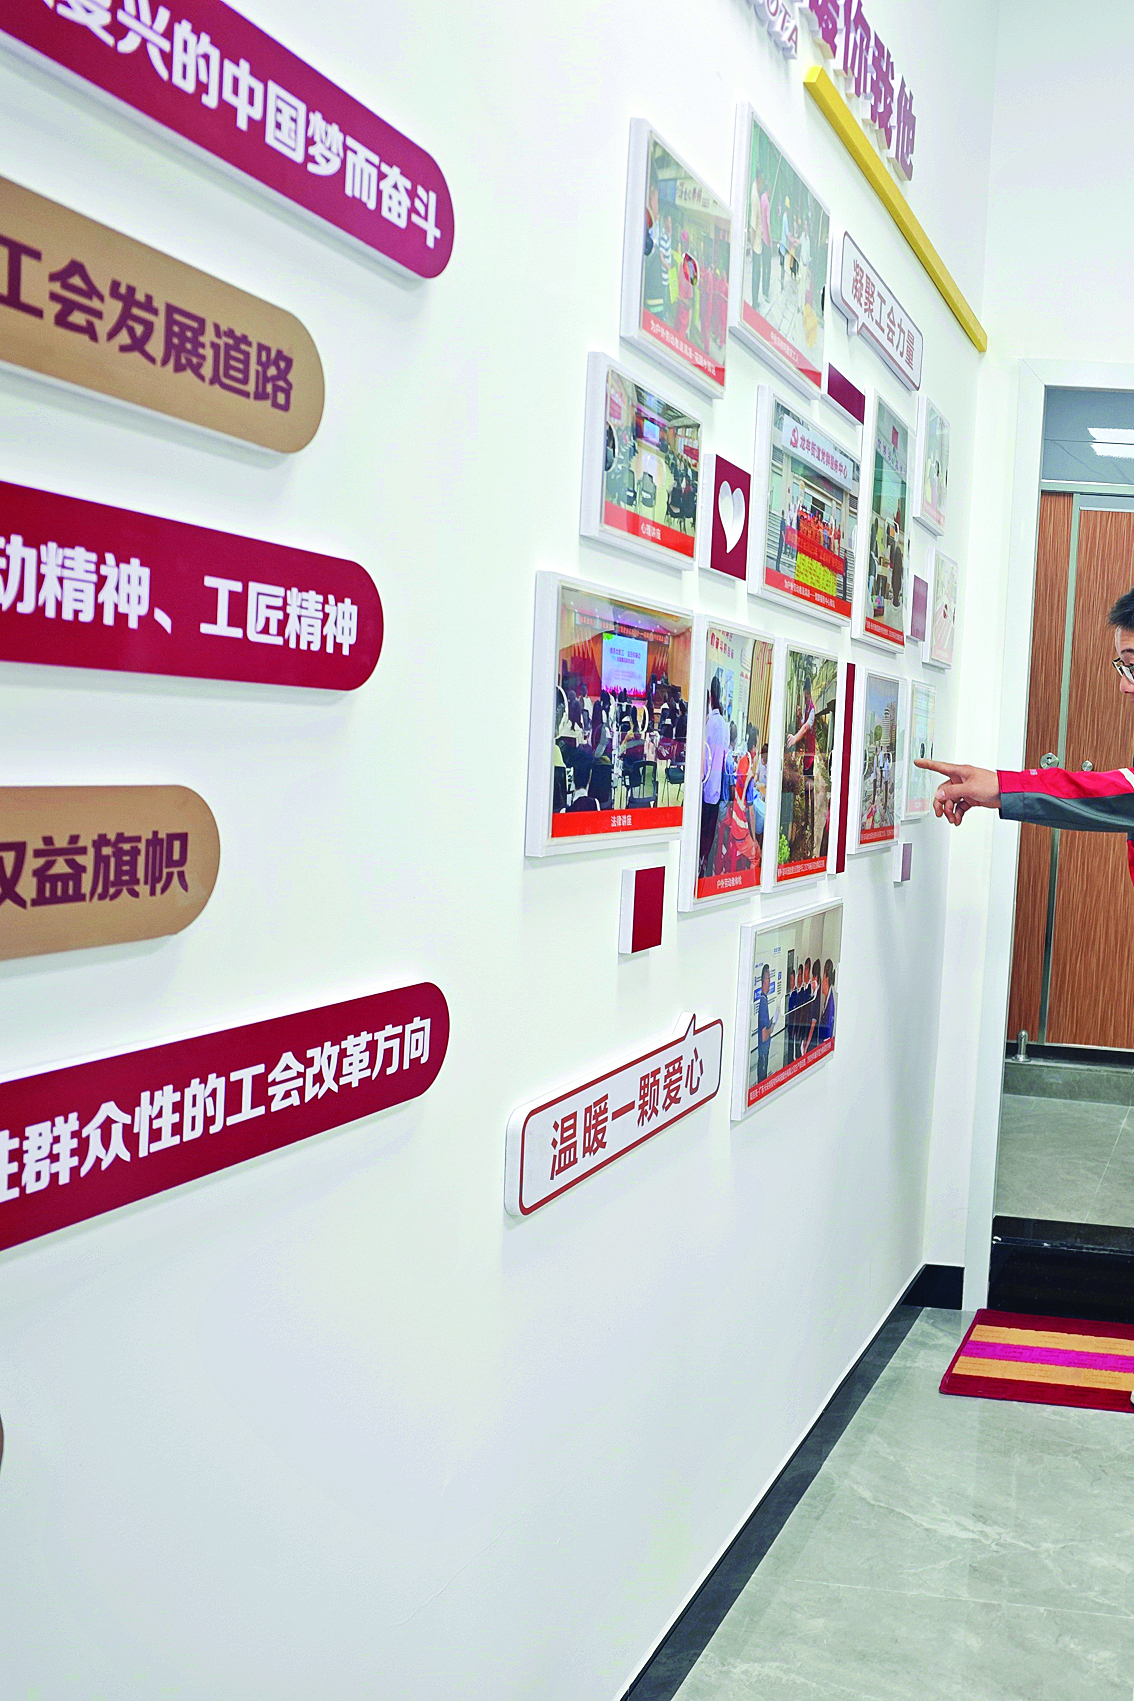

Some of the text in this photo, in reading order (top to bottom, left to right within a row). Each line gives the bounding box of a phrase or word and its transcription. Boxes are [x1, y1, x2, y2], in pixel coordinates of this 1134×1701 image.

[0, 233, 294, 412] 工会发展道路
[853, 259, 915, 372] 凝聚工会力量
[641, 522, 662, 541] 心理讲座
[611, 814, 632, 827] 法律讲座
[550, 1046, 705, 1181] 温暖一颗爱心
